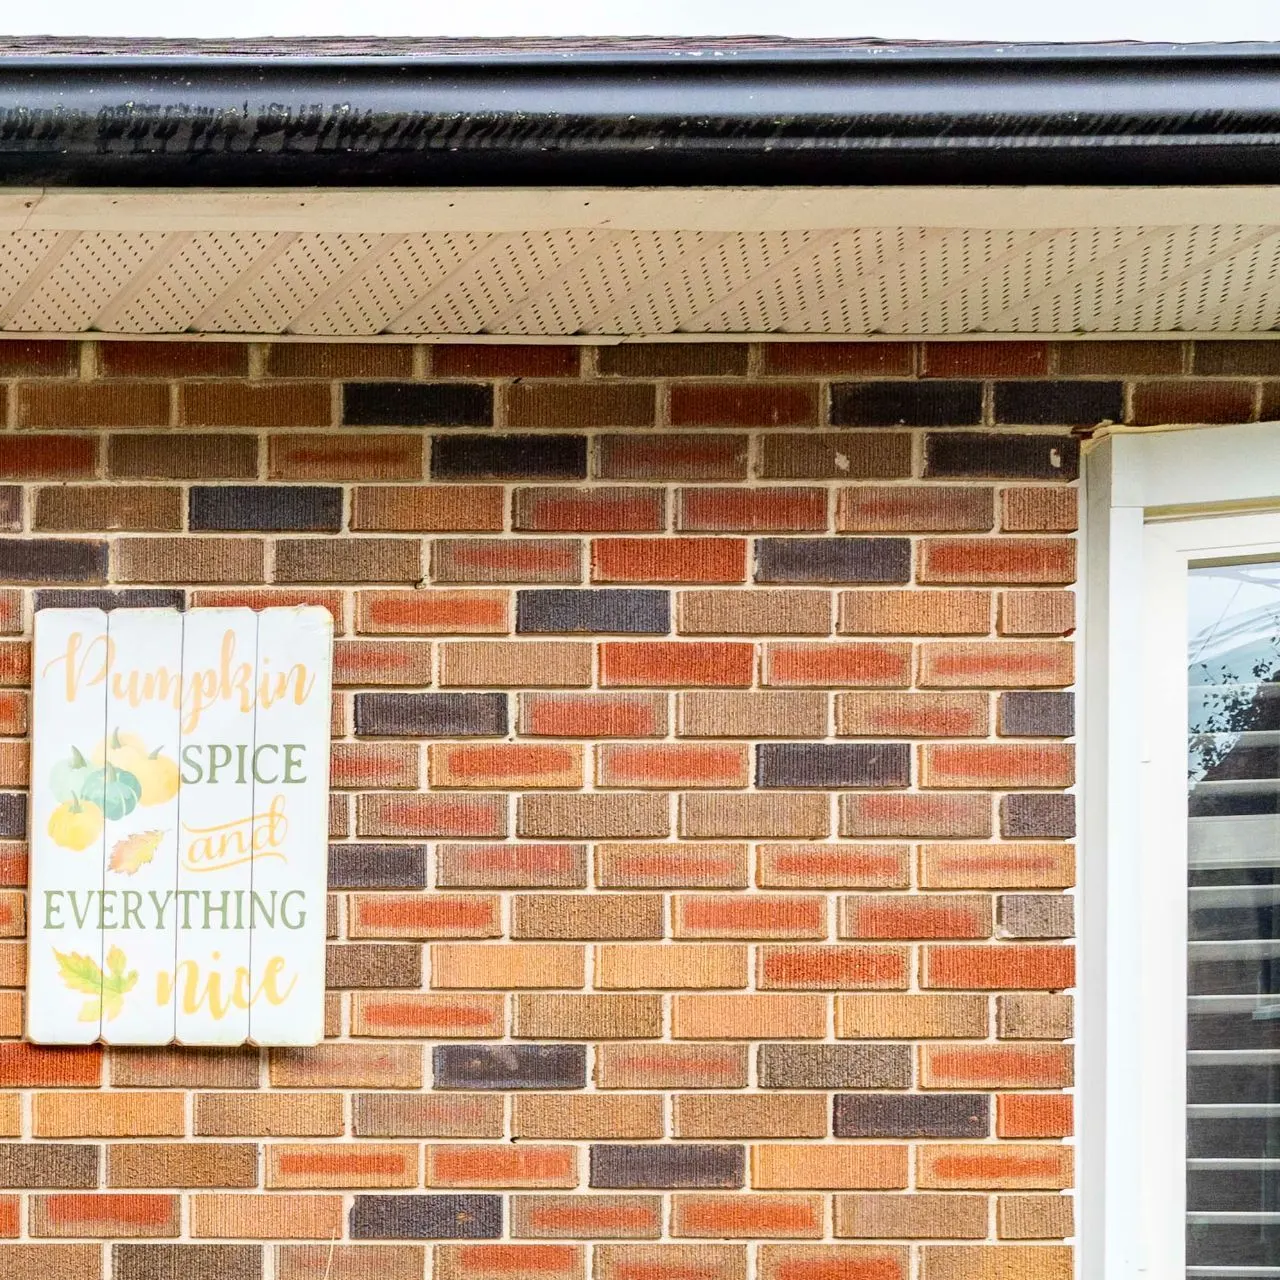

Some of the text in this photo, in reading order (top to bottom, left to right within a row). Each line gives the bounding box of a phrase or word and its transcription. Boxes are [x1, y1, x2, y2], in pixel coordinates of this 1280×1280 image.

[42, 628, 316, 735] Pumpkin
[180, 743, 307, 785] SPICE
[182, 793, 288, 873] and
[42, 889, 307, 931] EVERYTHING
[155, 950, 298, 1021] nice
